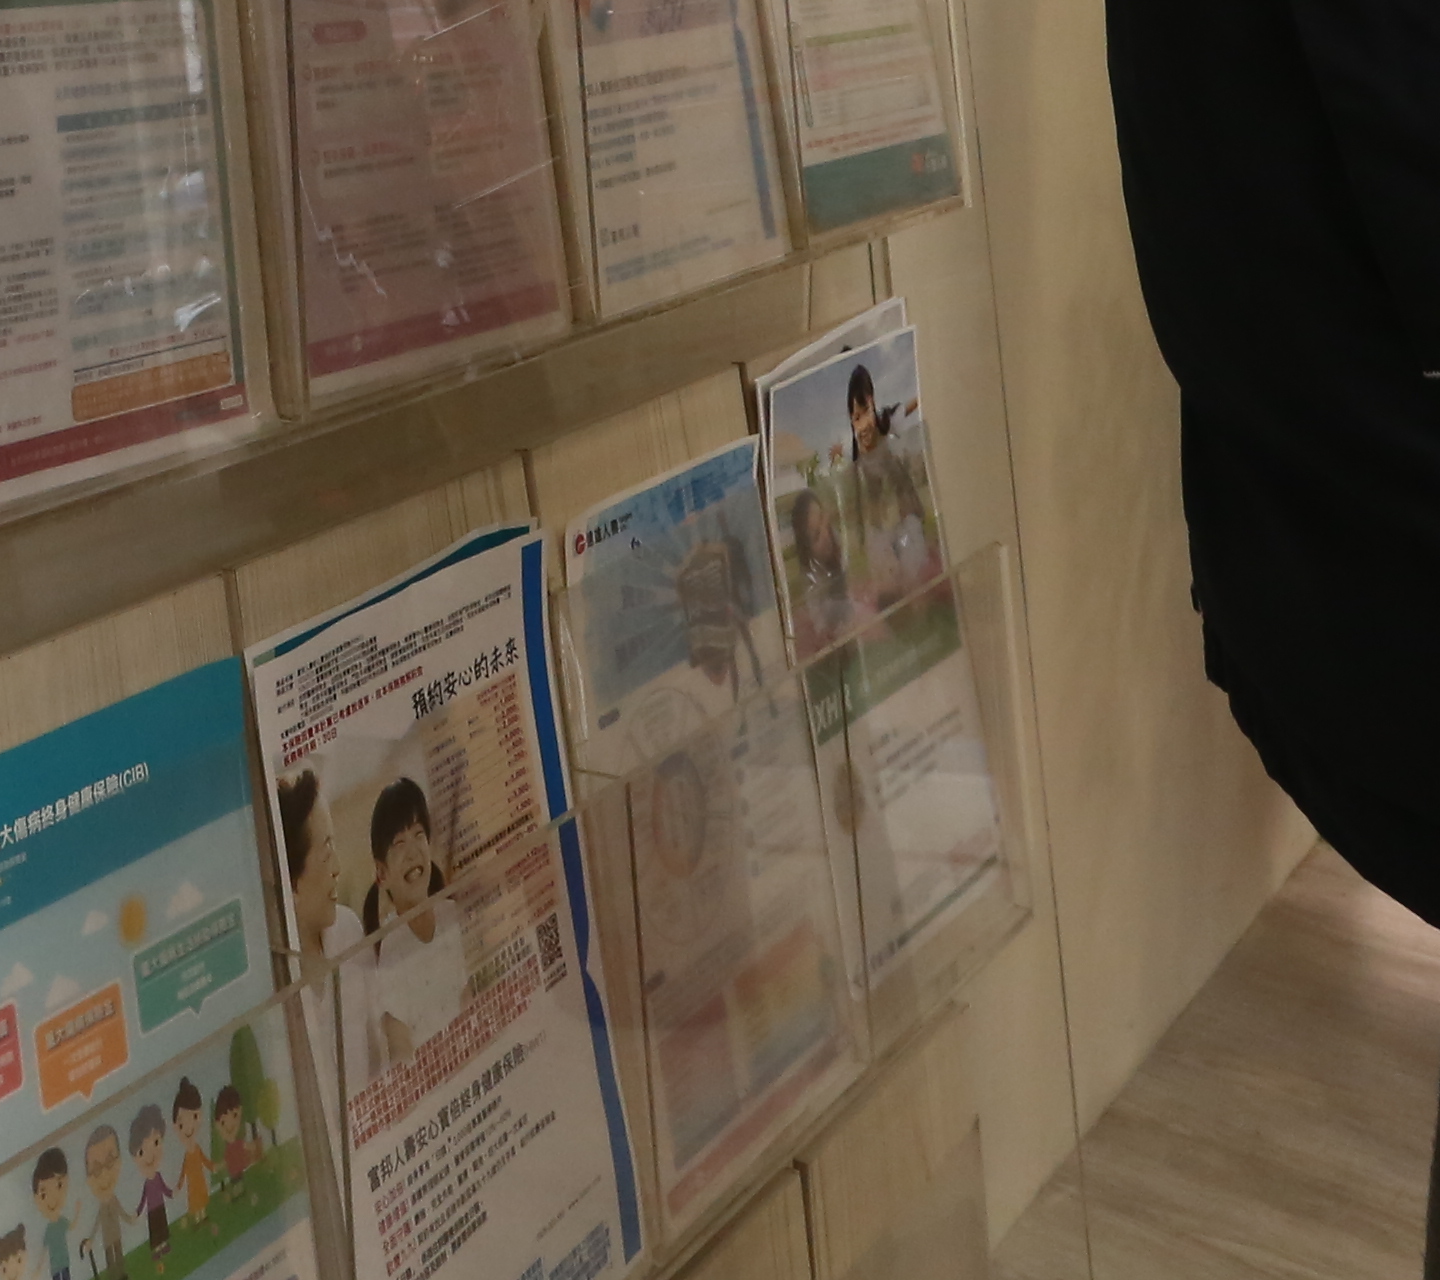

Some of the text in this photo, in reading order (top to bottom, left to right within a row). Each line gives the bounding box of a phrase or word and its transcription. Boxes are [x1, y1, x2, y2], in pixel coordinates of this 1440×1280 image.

[411, 636, 520, 720] 預約安心的未來
